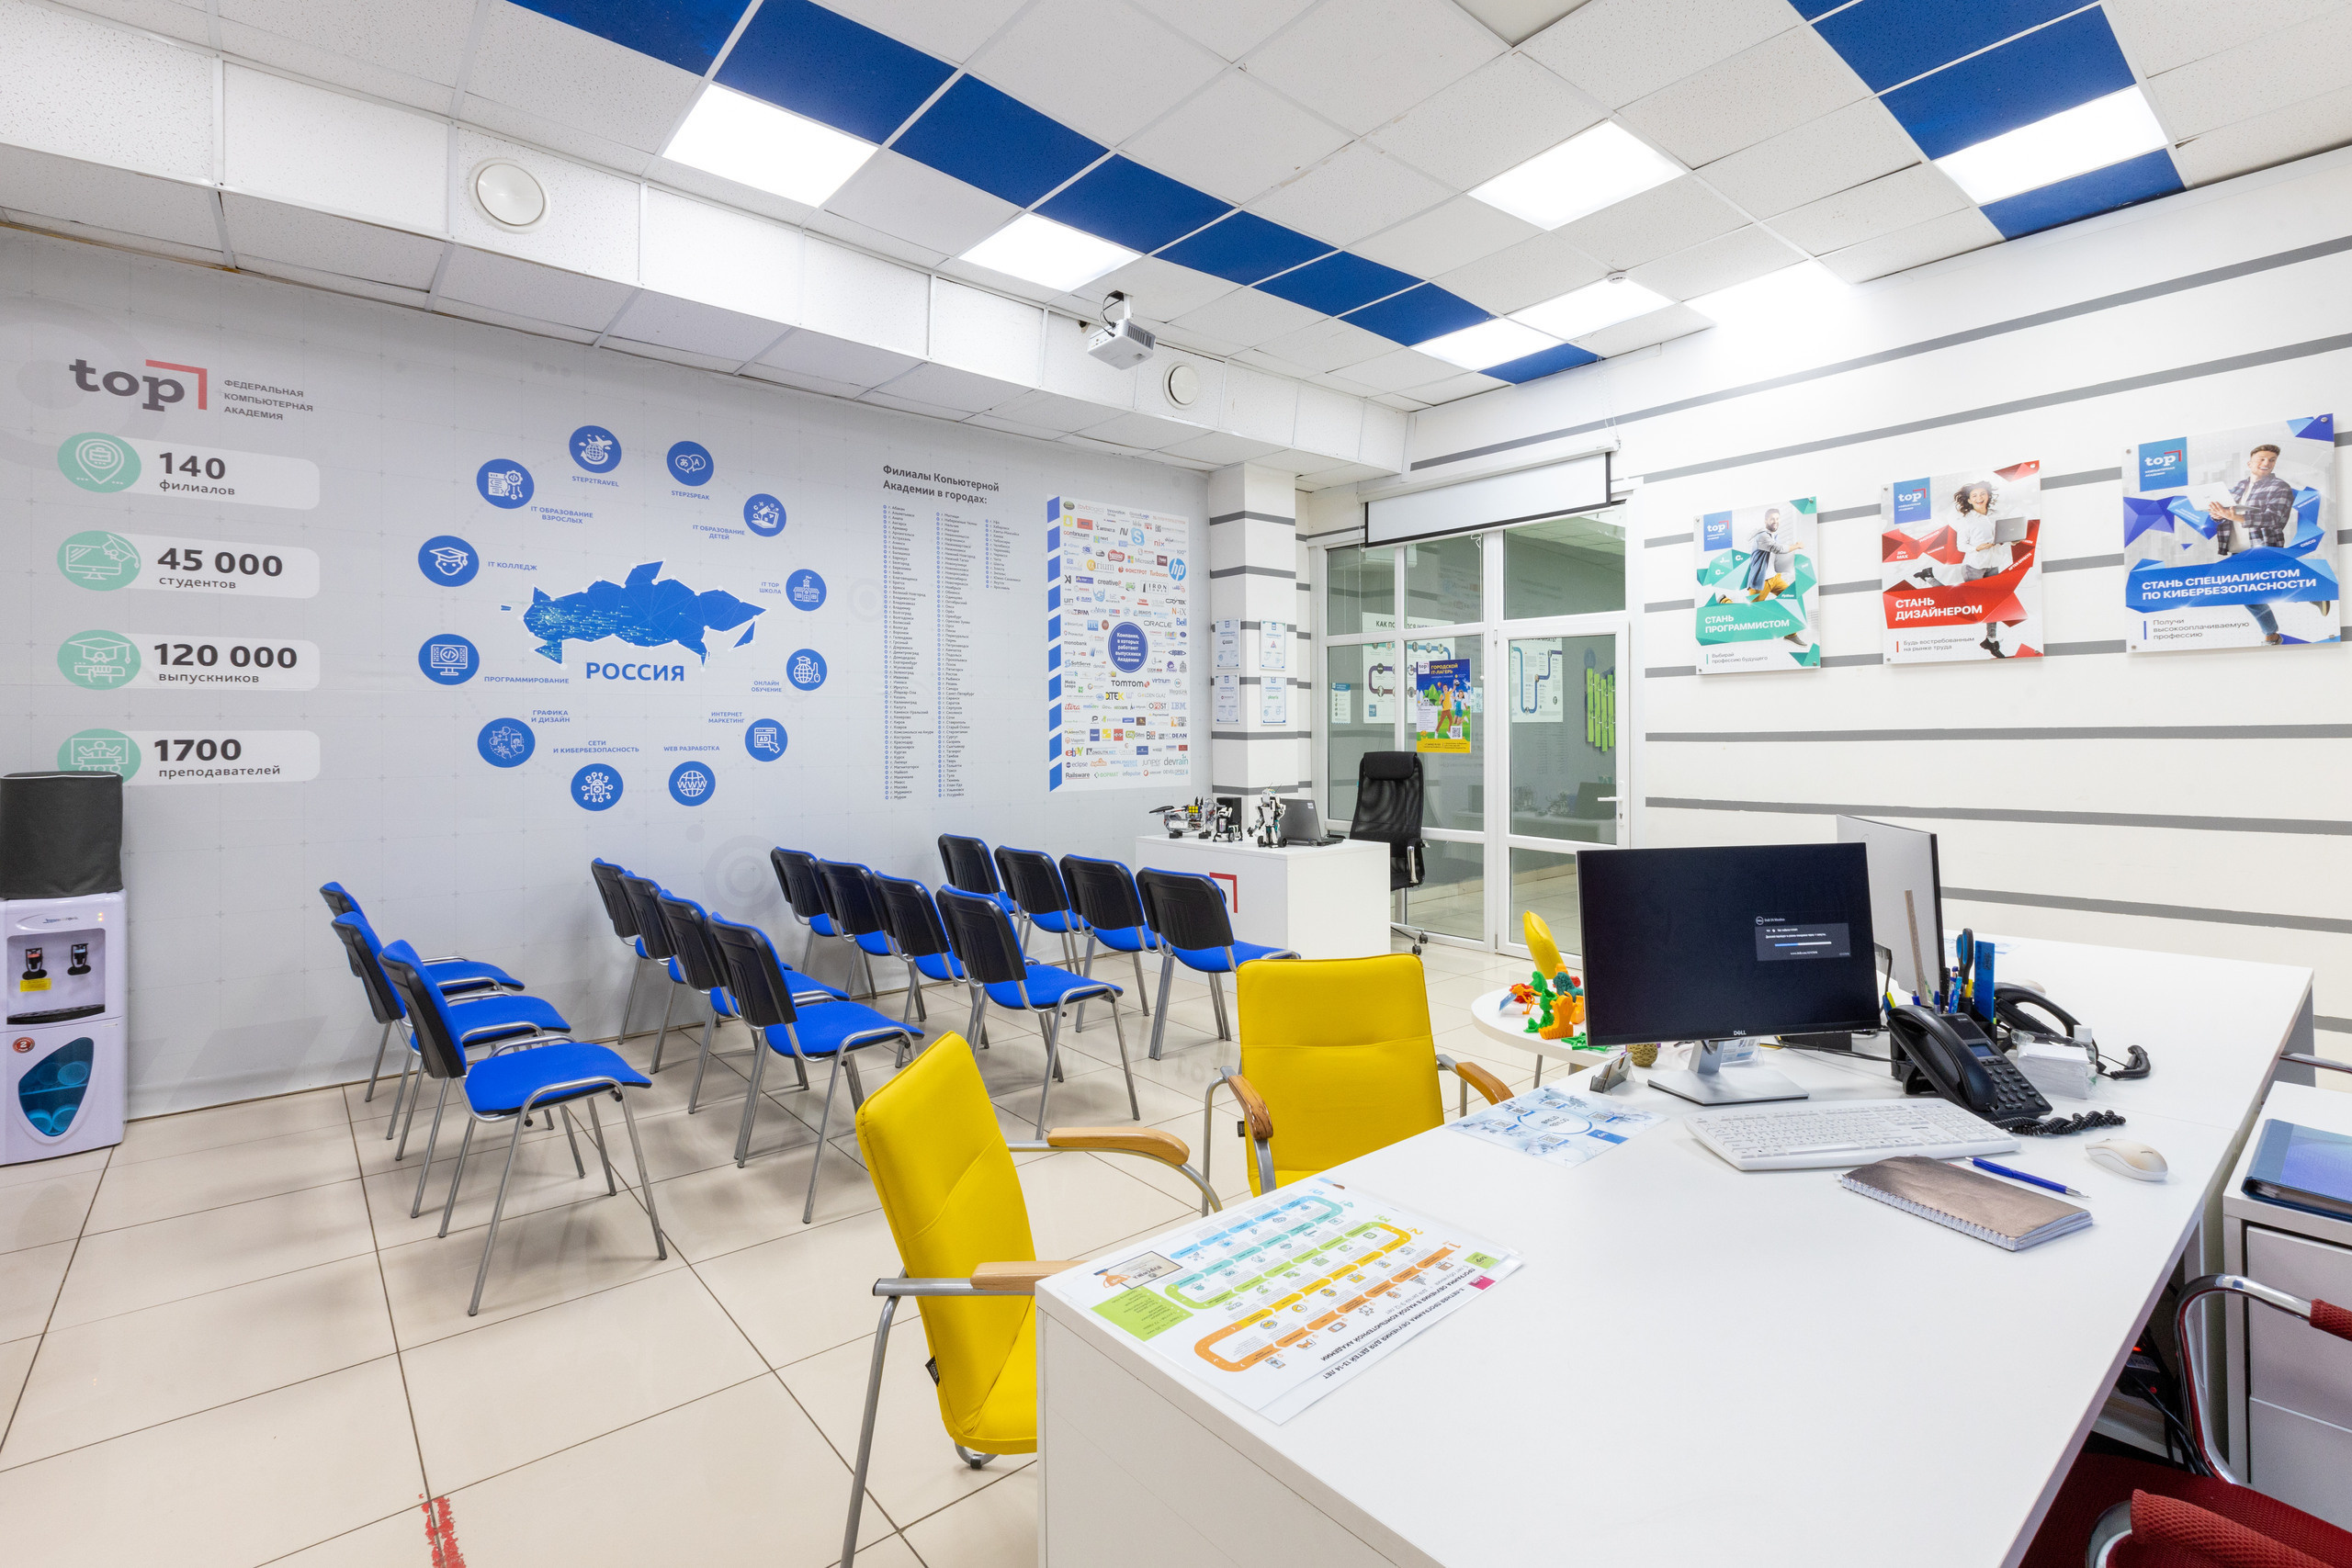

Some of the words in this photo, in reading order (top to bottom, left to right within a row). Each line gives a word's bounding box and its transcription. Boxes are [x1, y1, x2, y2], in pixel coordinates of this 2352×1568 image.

[69, 358, 185, 412] top
[223, 379, 304, 398] ФЕДЕРАЛЬНАЯ
[223, 392, 314, 412] КОМПЬЮТЕРНАЯ
[223, 406, 284, 422] АКАДЕМИЯ
[159, 451, 226, 480] 140
[2144, 455, 2177, 467] top
[571, 475, 620, 489] STEP2TRAVEL
[883, 465, 932, 481] Филиалы
[933, 473, 1001, 492] Копьютерной
[159, 479, 236, 496] филиалов
[883, 479, 935, 498] Академии
[944, 491, 988, 505] городах:
[671, 490, 710, 501] STEP2SPEAK
[1897, 491, 1922, 502] top
[530, 505, 538, 513] IT
[538, 506, 594, 520] ОБРАЗОВАНИЕ
[541, 513, 584, 525] ВЗРОСЛЫХ
[699, 525, 746, 536] ОБРАЗОВАНИЕ
[1706, 523, 1726, 534] top
[708, 532, 730, 541] ДЕТЕЙ
[156, 547, 204, 572] 45
[213, 551, 284, 578] 000
[488, 560, 497, 569] IT
[497, 561, 538, 571] КОЛЛЕДЖ
[158, 576, 237, 590] студентов
[2142, 579, 2183, 592] СТАНЬ
[2185, 569, 2301, 588] СПЕЦИАЛИСТОМ
[2142, 591, 2164, 601] ПО
[2163, 578, 2317, 599] КИБЕРБЕЗОПАСНОСТИ
[1895, 597, 1935, 610] СТАНЬ
[1705, 615, 1735, 624] СТАНЬ
[1895, 604, 1983, 621] ДИЗАЙНЕРОМ
[1144, 620, 1173, 628] ORACLE
[1176, 617, 1187, 626] Bell
[1705, 619, 1791, 634] ПРОГРАММИСТОМ
[2153, 618, 2185, 626] Получи
[2153, 621, 2250, 633] высокооплачиваемую
[1917, 636, 1975, 646] востребованным
[2153, 631, 2203, 640] профессию
[1911, 645, 1931, 653] рынке
[153, 643, 219, 667] 120
[229, 646, 298, 670] 000
[585, 660, 685, 682] РОССИЯ
[158, 672, 260, 685] выпускников
[483, 676, 570, 685] ПРОГРАММИРОВАНИЕ
[532, 709, 569, 717] ГРАФИКА
[1170, 702, 1187, 710] IBM
[537, 716, 571, 725] ДИЗАЙН
[153, 739, 243, 762] 1700
[559, 746, 640, 754] КИБЕРБЕЗОПАСНОСТЬ
[1163, 755, 1189, 766] devrain
[158, 765, 281, 780] преподавателей
[1447, 1268, 1476, 1288] ПРОГРАММА
[1421, 1285, 1449, 1303] ОБУЧЕНИЯ
[1397, 1301, 1419, 1316] МАЛОЙ
[1353, 1314, 1399, 1343] КОМПЬЮТЕРНОЙ
[1381, 1320, 1411, 1342] ОБУЧЕНИЯ
[1320, 1340, 1355, 1361] АКАДЕМИИ
[1350, 1347, 1370, 1362] ДЕТЕЙ
[1322, 1370, 1336, 1380] ЛЕТ
